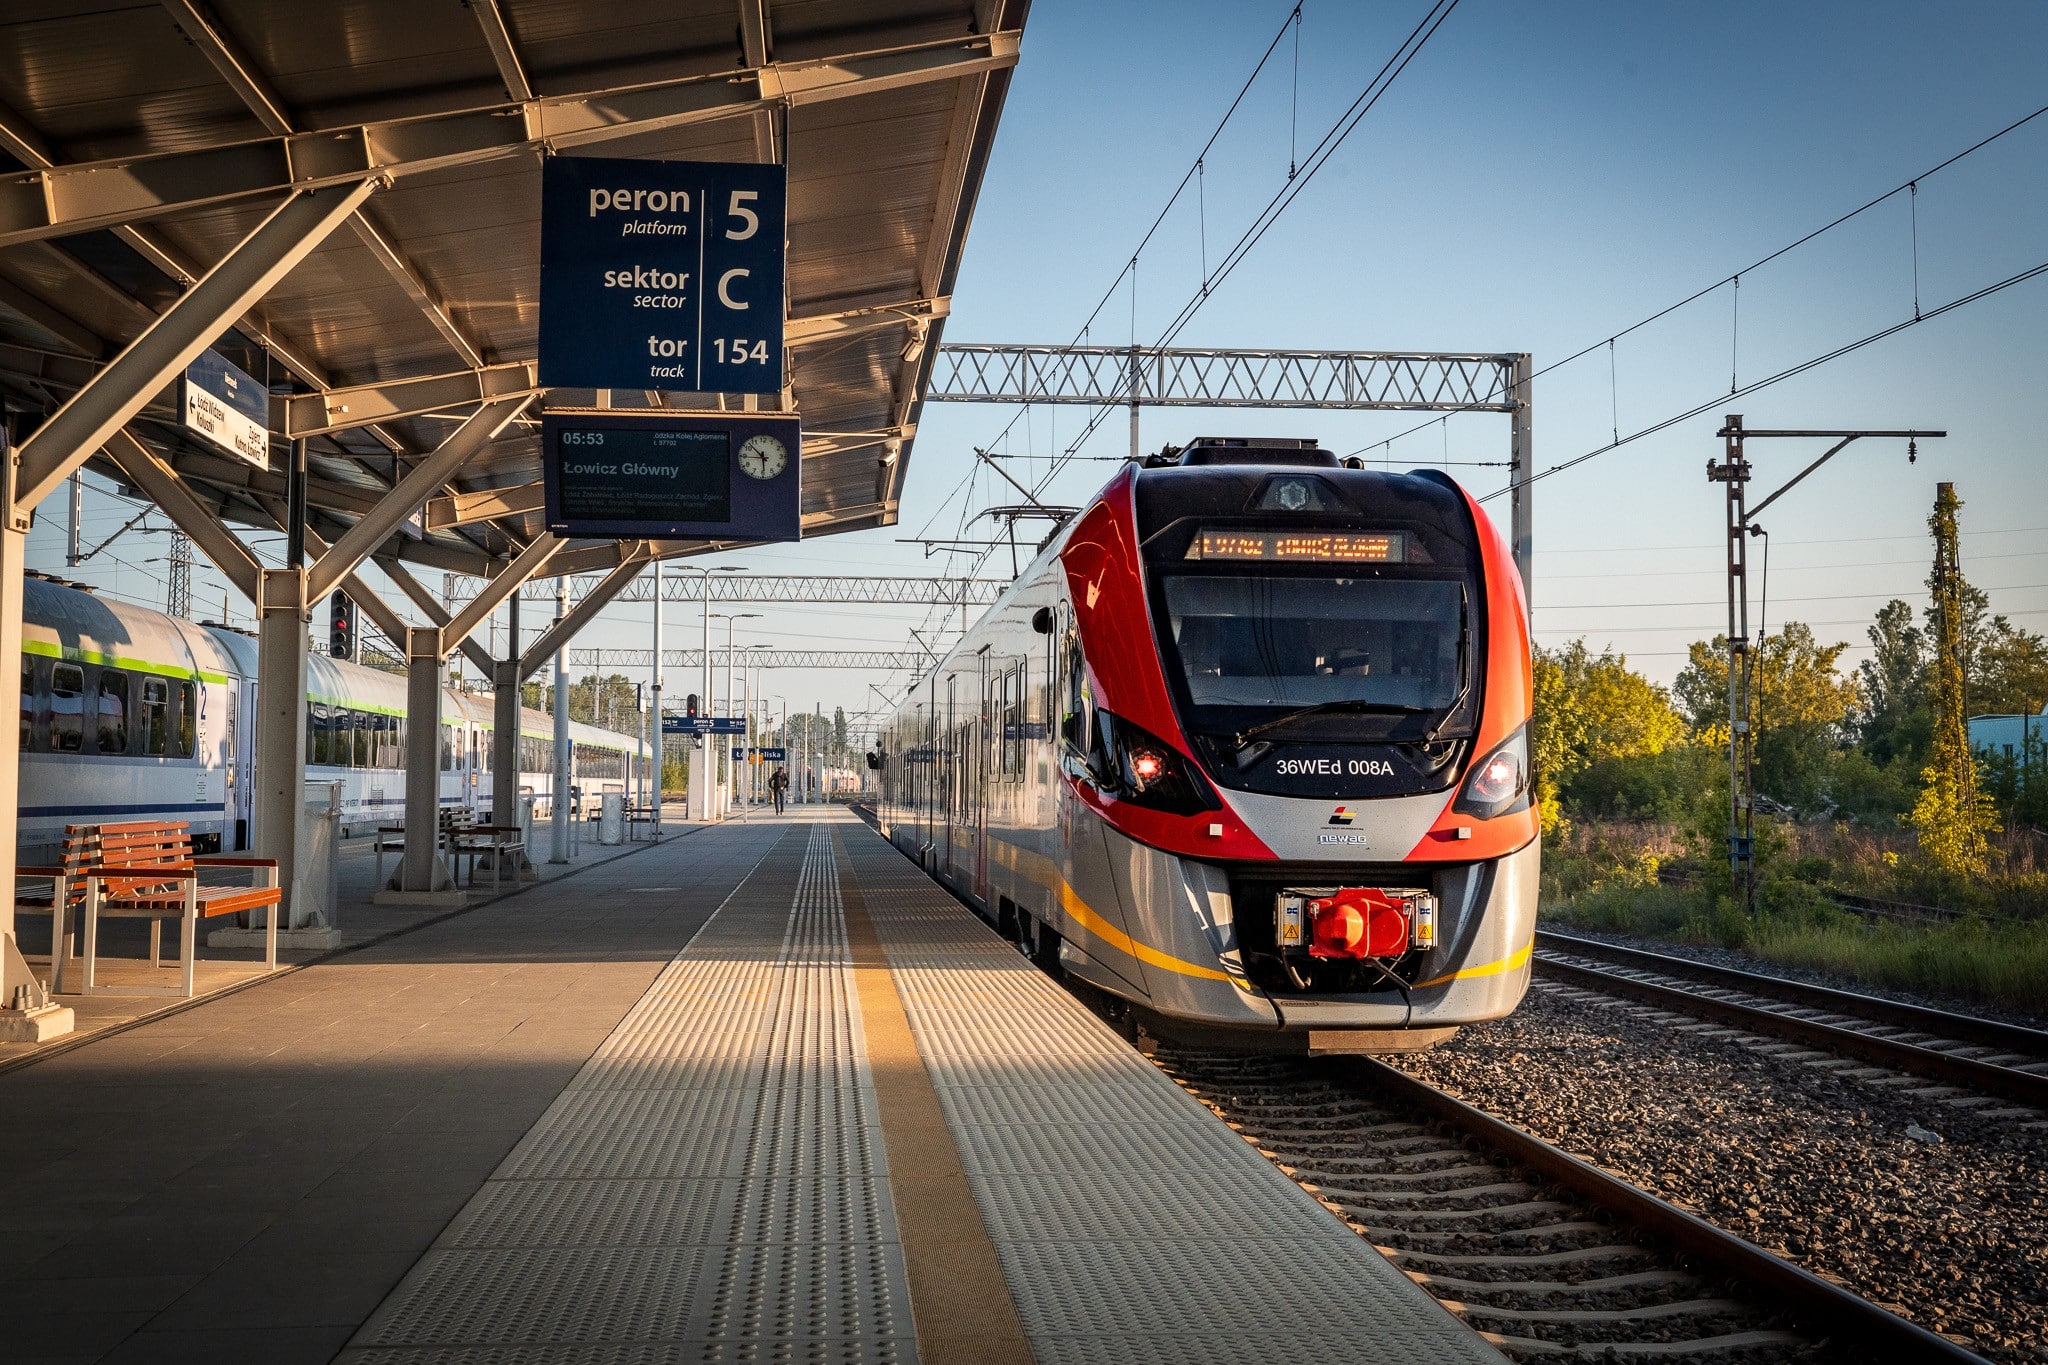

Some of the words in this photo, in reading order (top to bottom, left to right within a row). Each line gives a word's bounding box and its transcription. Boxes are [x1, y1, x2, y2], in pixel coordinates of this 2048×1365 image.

[589, 188, 690, 218] peron
[725, 190, 759, 241] 5
[622, 219, 687, 237] platform
[604, 265, 690, 290] sektor
[717, 268, 750, 310] C
[633, 294, 686, 309] sector
[648, 335, 688, 358] tor
[713, 338, 769, 365] 154
[650, 364, 685, 378] track
[196, 411, 215, 434] Koluszki
[562, 431, 605, 446] 05:53
[653, 432, 675, 440] ódzka
[675, 432, 693, 441] Kolej
[563, 461, 618, 475] Łowicz
[621, 462, 679, 479] Główny
[200, 685, 207, 720] 2
[708, 719, 715, 727] 5
[1276, 759, 1342, 775] 36WEd
[1348, 760, 1395, 776] 008A
[1320, 834, 1367, 845] newag
